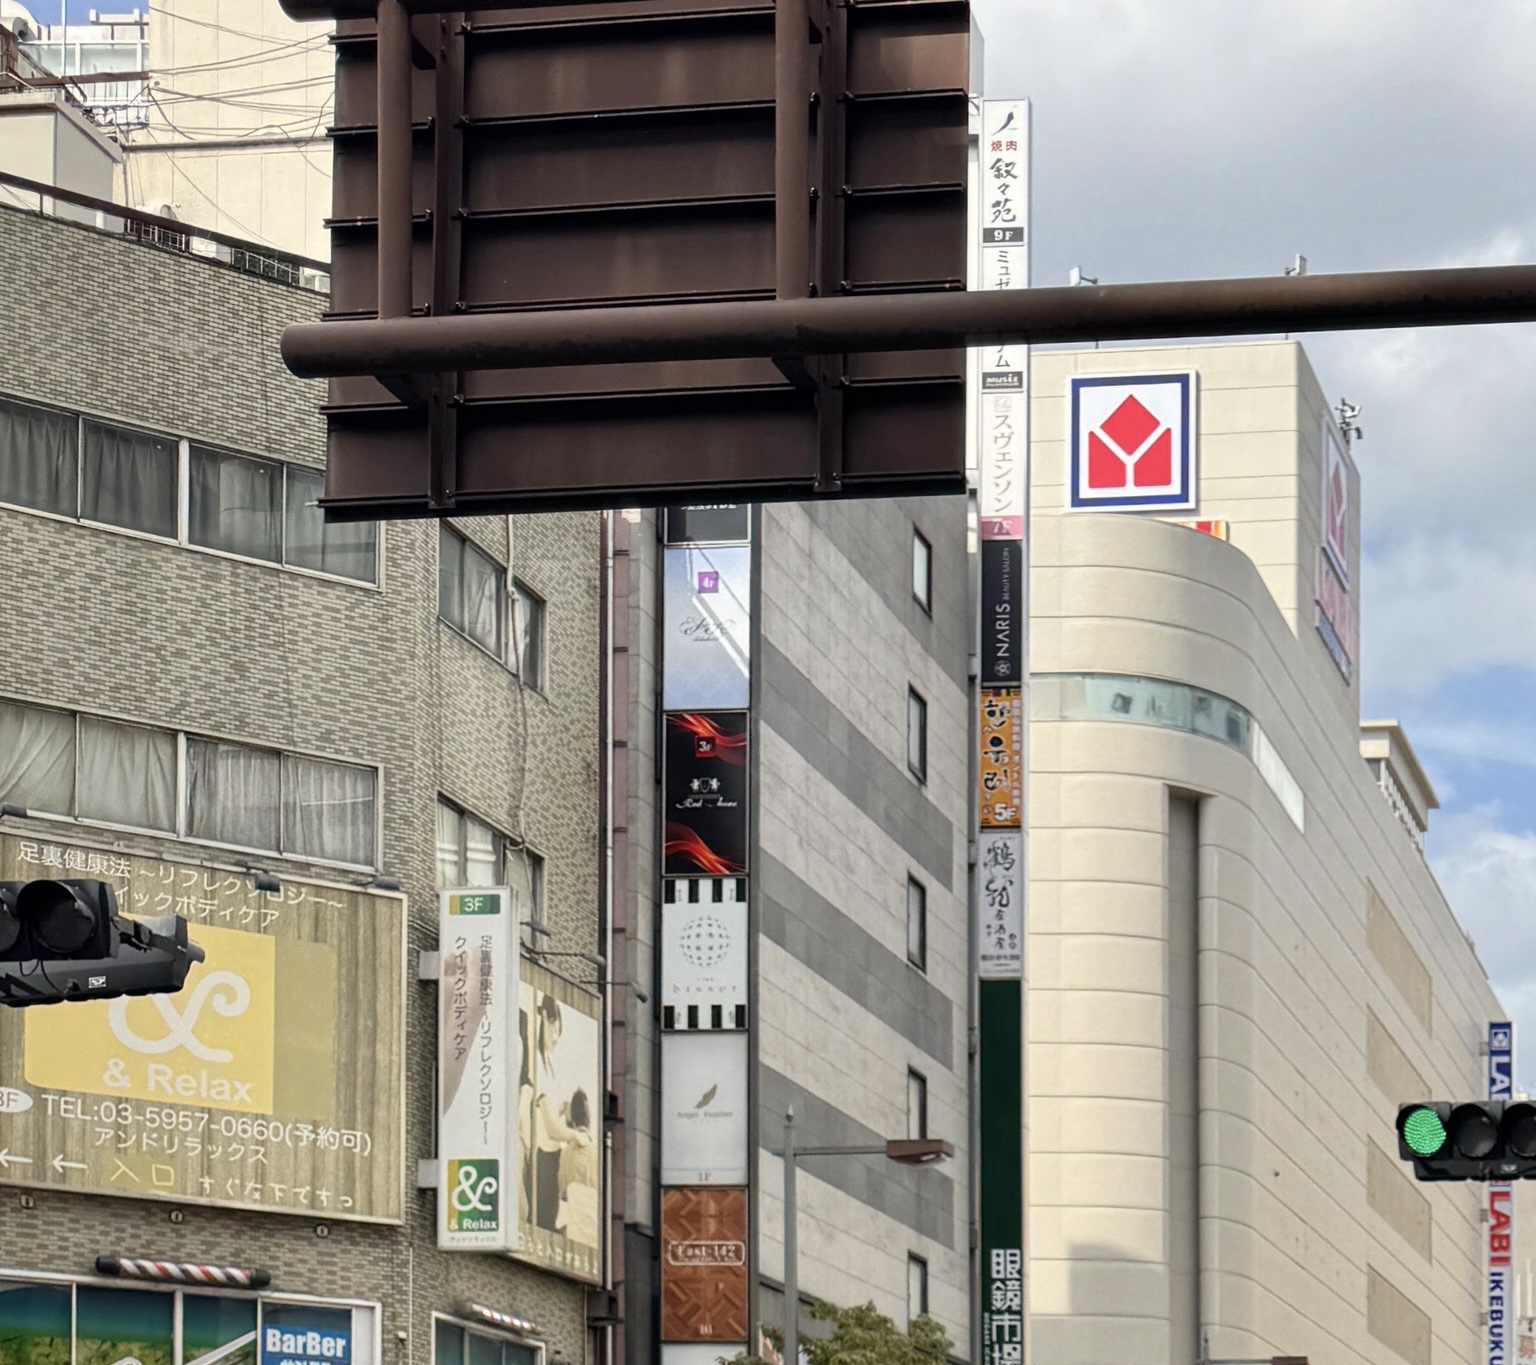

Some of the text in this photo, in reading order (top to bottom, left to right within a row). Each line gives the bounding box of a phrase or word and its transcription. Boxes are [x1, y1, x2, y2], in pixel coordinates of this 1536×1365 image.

[991, 140, 1018, 152] 焼肉
[988, 157, 1018, 223] 叙々苑
[993, 229, 1014, 241] 9F
[994, 414, 1015, 513] スヴェンソン
[995, 603, 1010, 657] NARIS
[994, 803, 1016, 821] 5F
[17, 840, 132, 880] 足裏健康法
[464, 898, 484, 912] 3F
[454, 935, 466, 1061] クイックボディケア
[103, 1058, 254, 1105] & Relax
[41, 1094, 373, 1152] TEL:03-5957-0660(予約可)
[95, 1127, 269, 1163] アンドリラックス
[110, 1157, 175, 1187] 入口
[463, 1218, 498, 1230] Relax
[1489, 1191, 1511, 1266] LABI
[266, 1329, 346, 1358] BarBer
